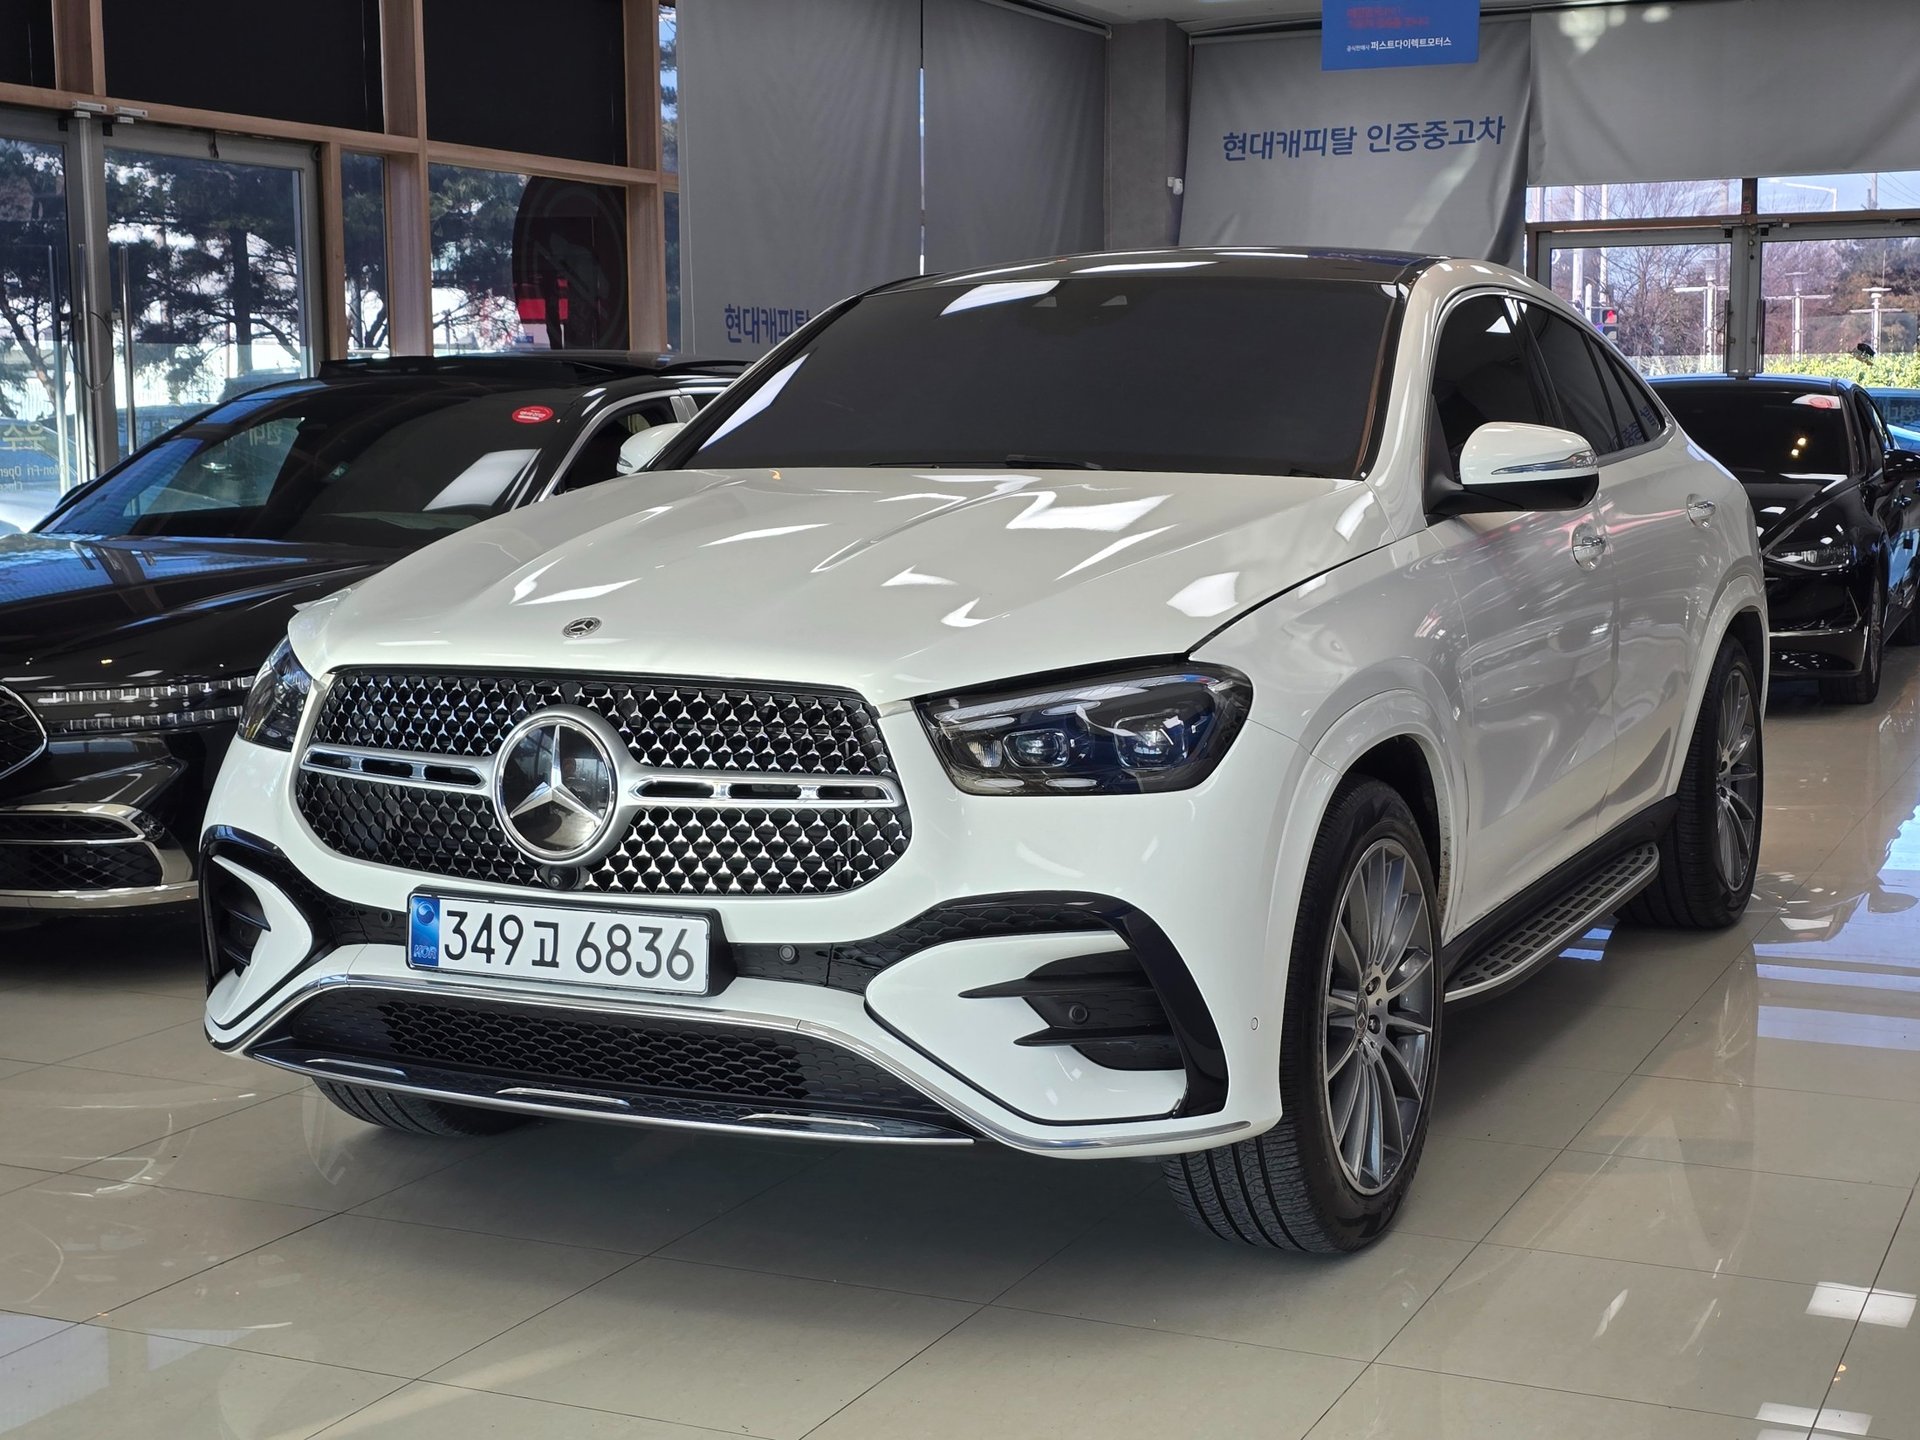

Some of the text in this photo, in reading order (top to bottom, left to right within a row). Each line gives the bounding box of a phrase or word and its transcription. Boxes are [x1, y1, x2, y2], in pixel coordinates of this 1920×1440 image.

[1370, 36, 1452, 51] 퍼스트다이렉트모터스
[1222, 115, 1506, 162] 현대캐피탈 인증중고차
[413, 944, 437, 960] KOR
[444, 909, 695, 982] 349고 6836
